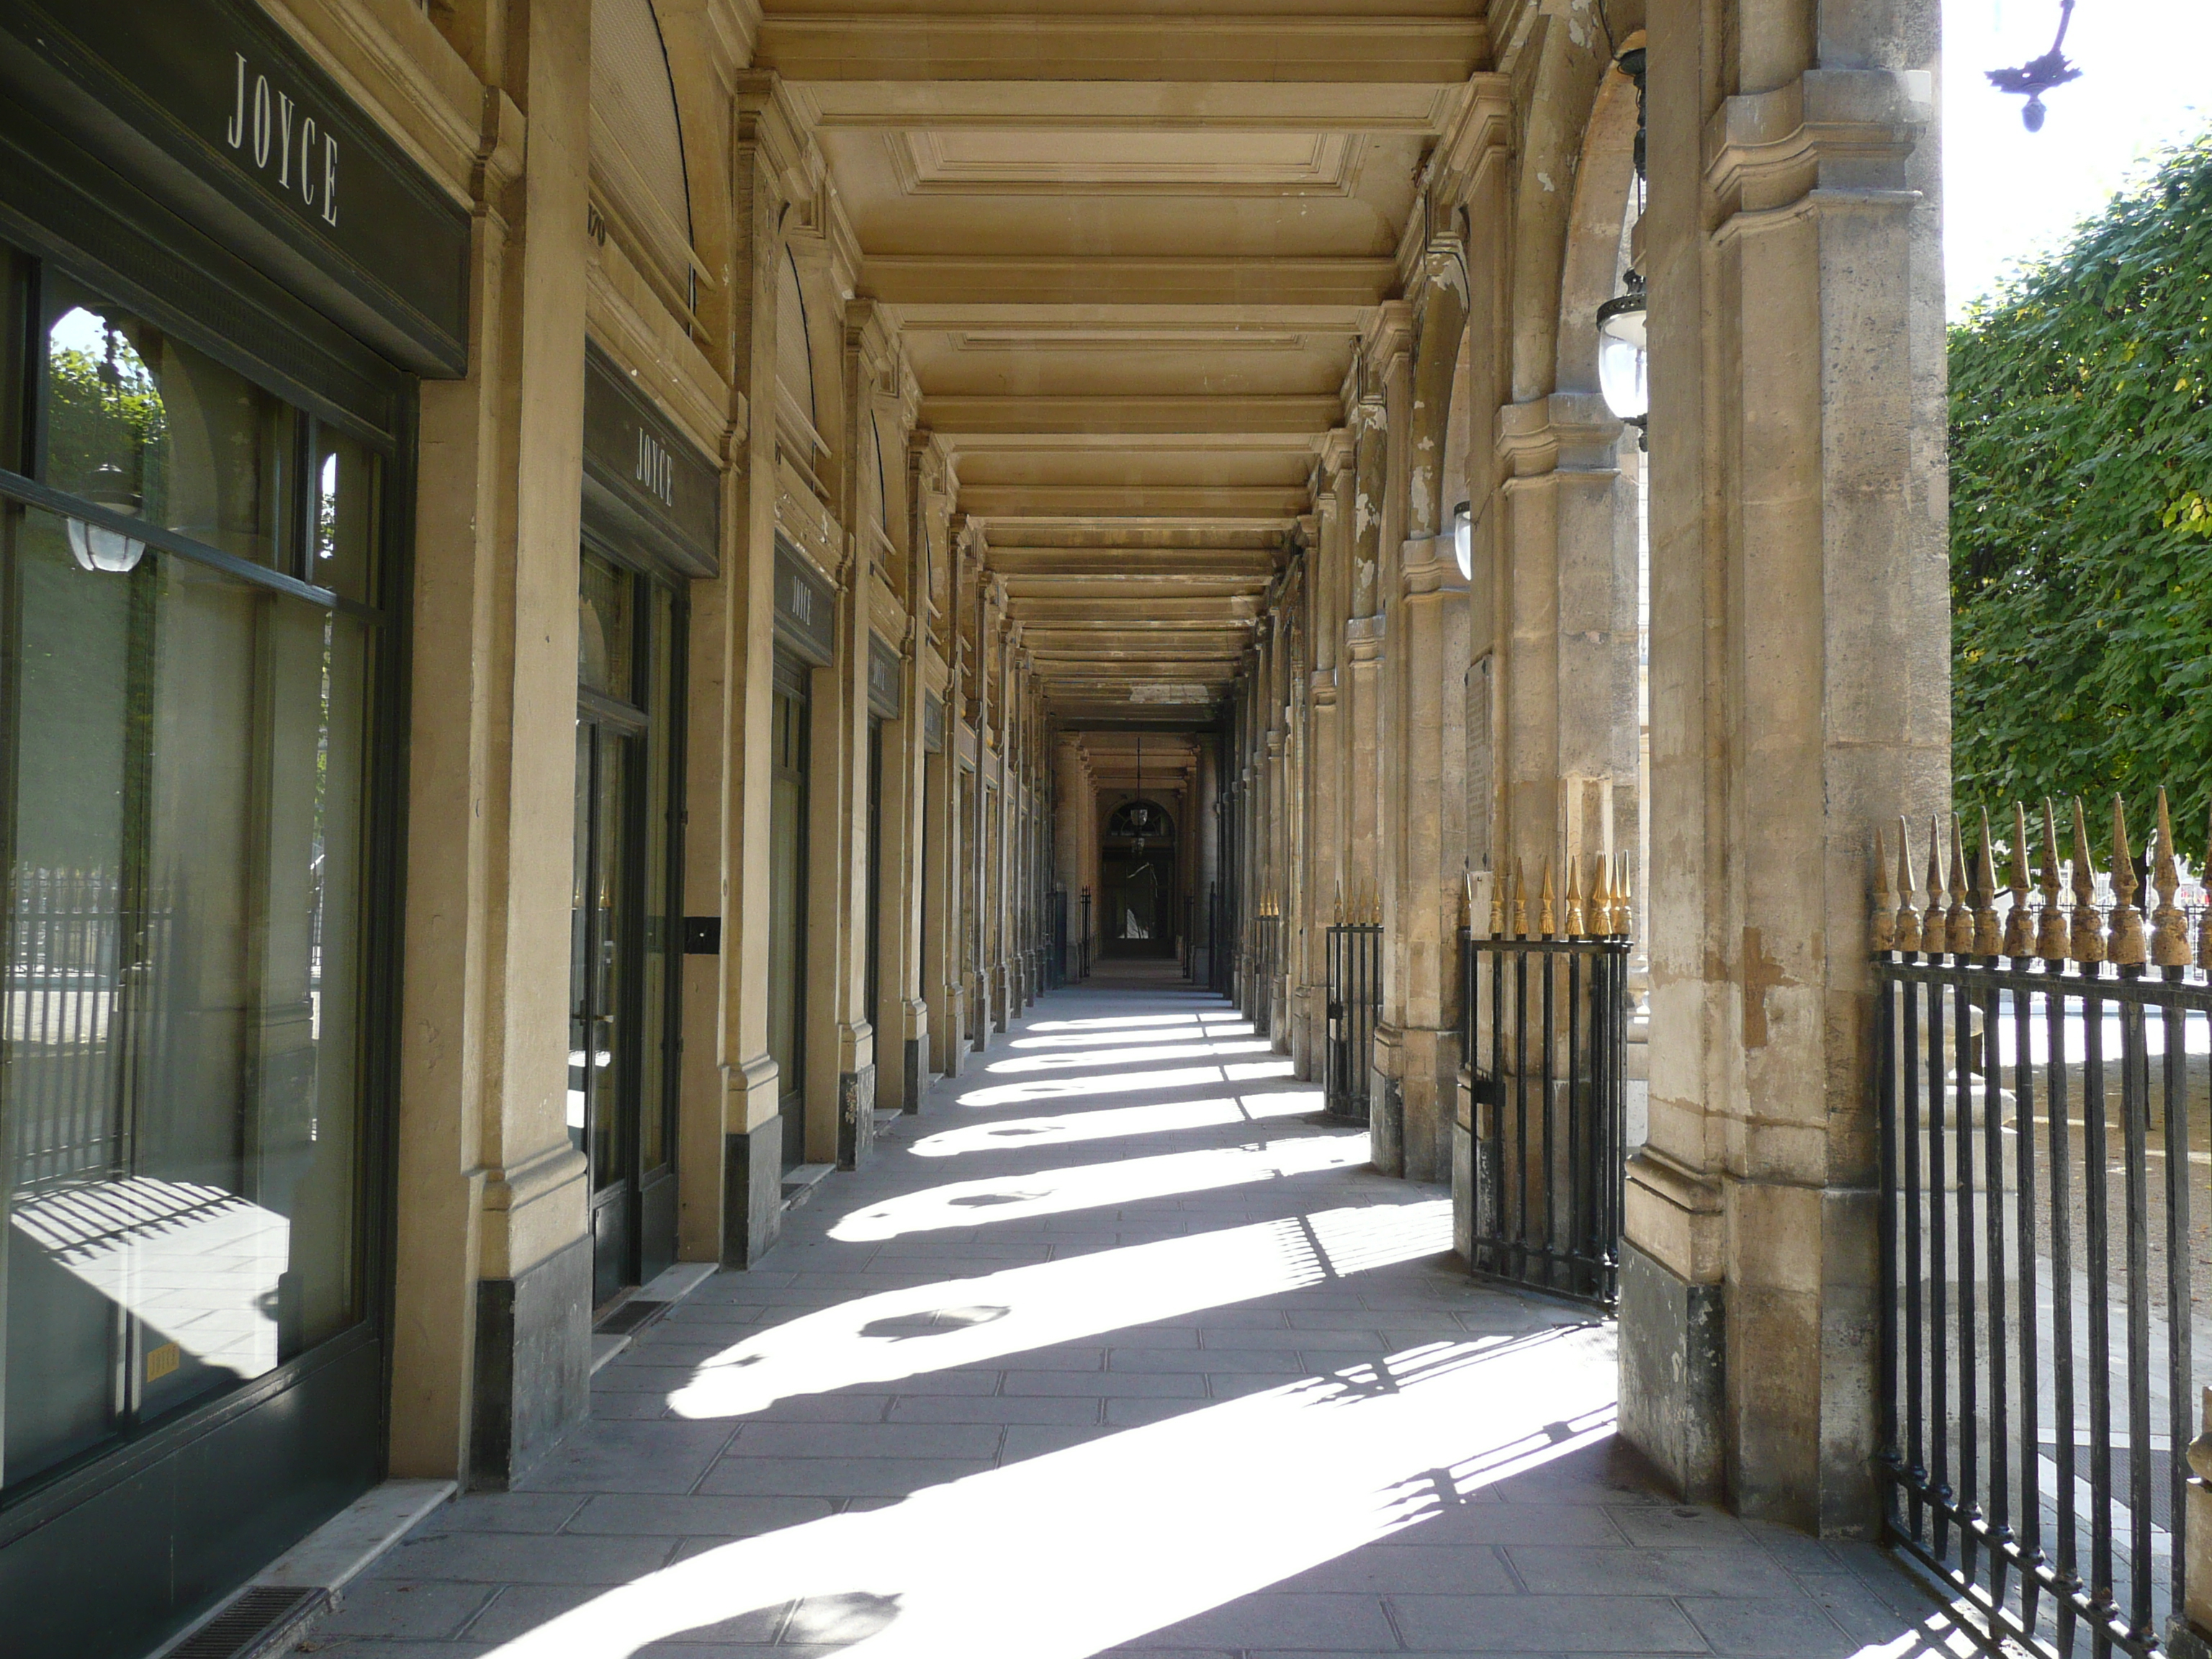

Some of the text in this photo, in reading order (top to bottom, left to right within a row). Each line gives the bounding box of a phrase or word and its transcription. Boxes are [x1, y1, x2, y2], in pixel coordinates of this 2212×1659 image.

[228, 51, 338, 228] JOYCE
[637, 427, 673, 507] JOYCE
[793, 576, 811, 626] JOYCE
